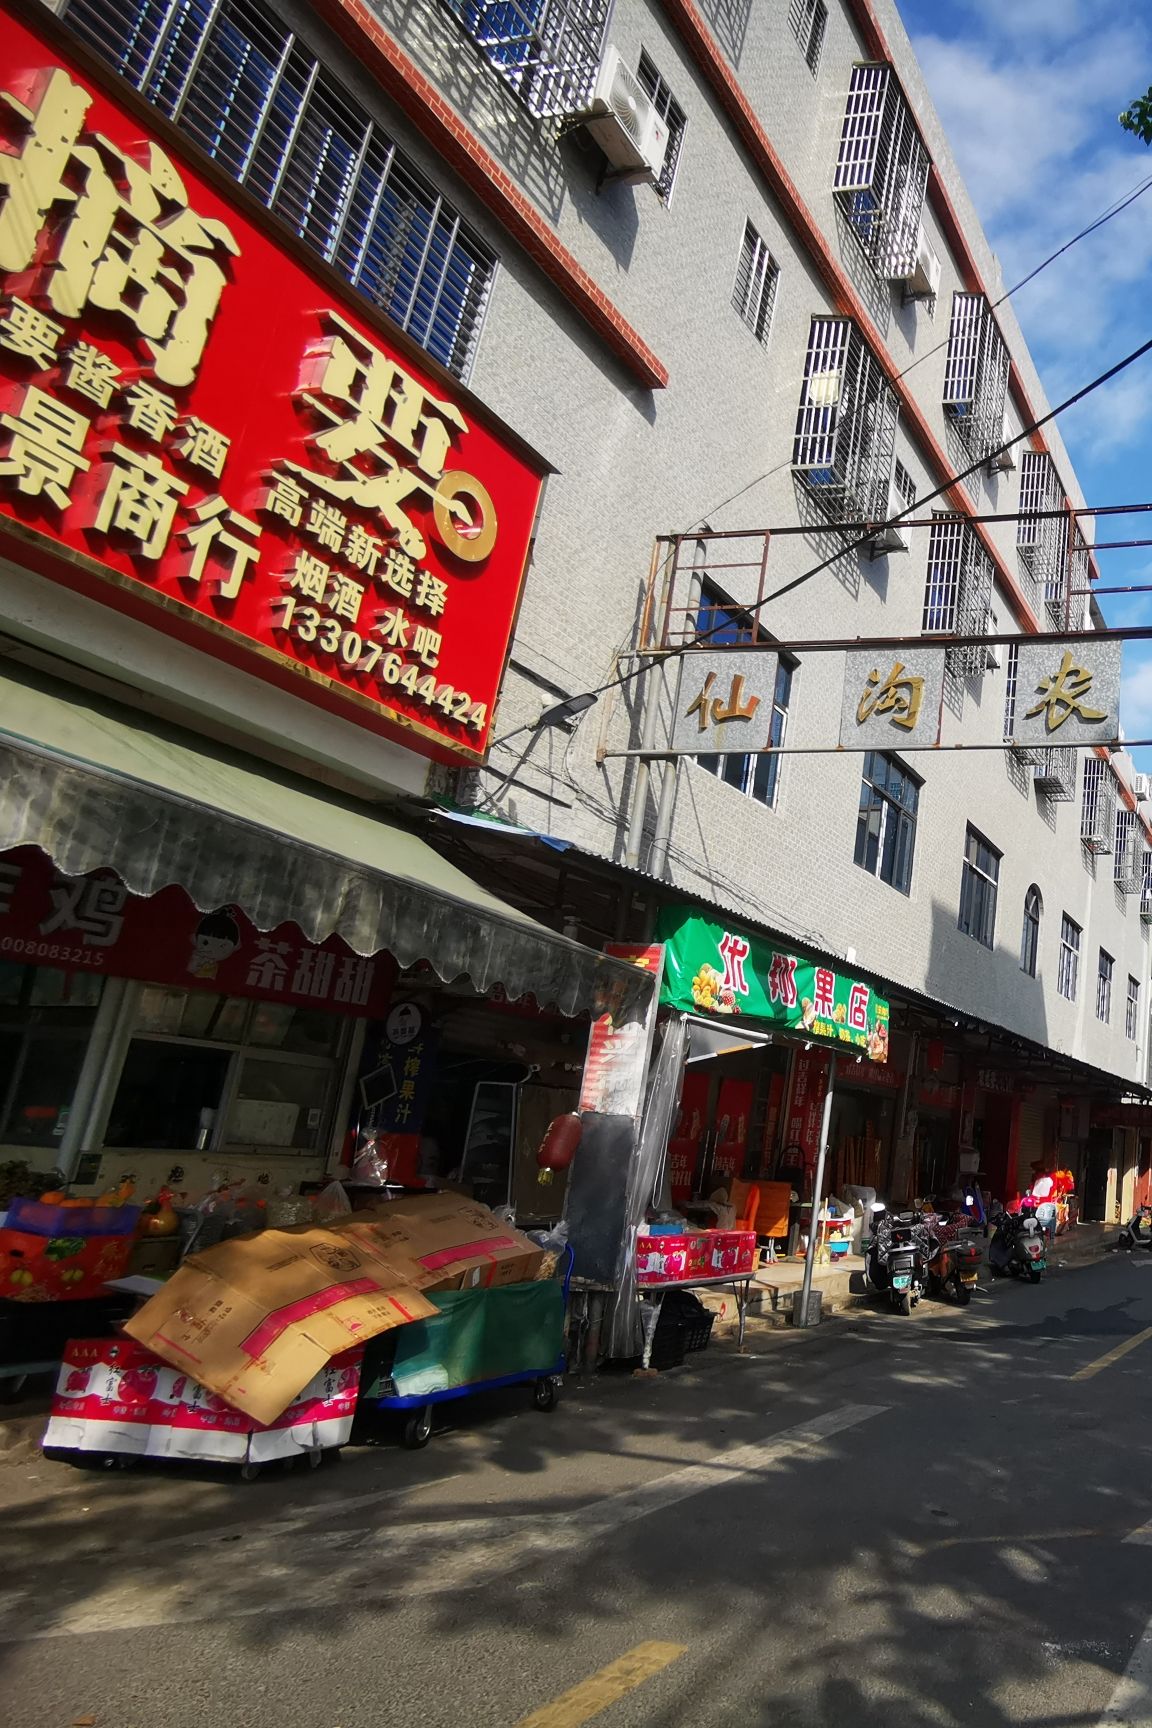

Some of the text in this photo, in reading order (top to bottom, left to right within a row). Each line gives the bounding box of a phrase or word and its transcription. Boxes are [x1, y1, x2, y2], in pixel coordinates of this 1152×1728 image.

[0, 296, 231, 479] 要酱香酒
[0, 385, 261, 600] 景商行
[265, 471, 448, 617] 高端新选择
[280, 596, 487, 732] 13307644424
[290, 551, 442, 669] 烟酒 水吧
[245, 938, 375, 1006] 茶甜甜
[718, 932, 871, 1031] 优翔果店
